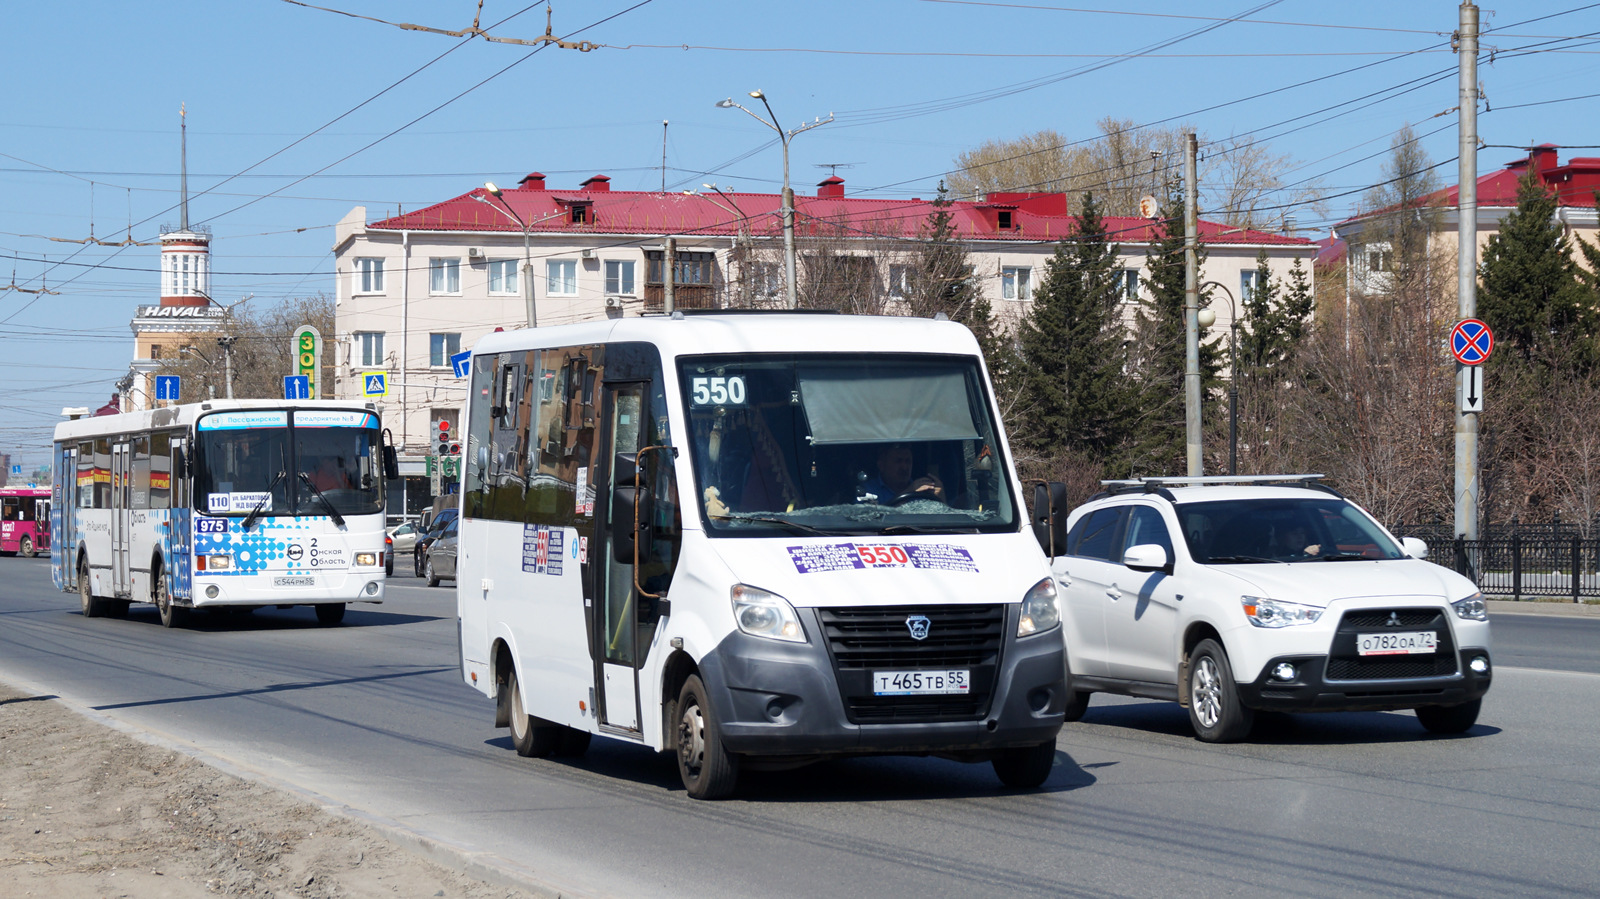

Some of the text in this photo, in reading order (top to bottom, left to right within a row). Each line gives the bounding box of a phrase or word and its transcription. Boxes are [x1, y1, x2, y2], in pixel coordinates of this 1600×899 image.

[145, 307, 204, 317] HAVAL
[693, 376, 745, 405] 550
[210, 496, 228, 507] 110
[200, 520, 224, 532] 975
[537, 531, 549, 565] 550
[857, 546, 908, 564] 550
